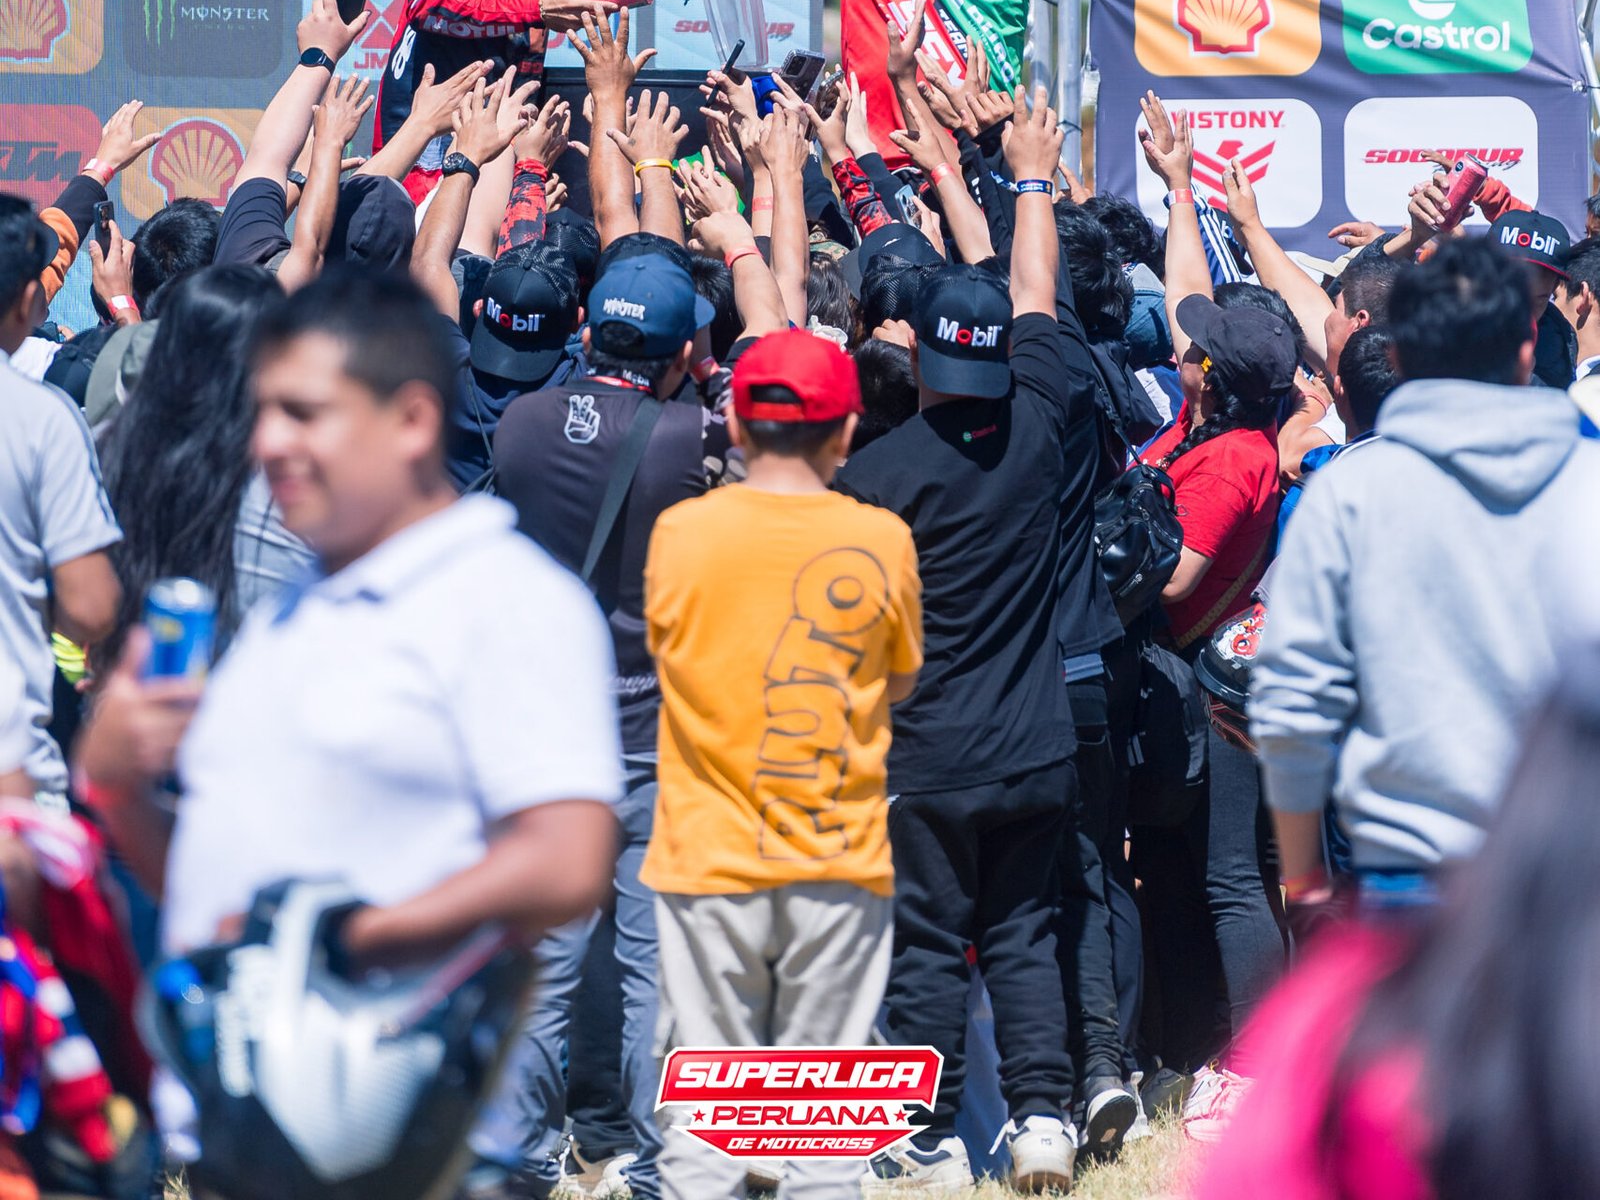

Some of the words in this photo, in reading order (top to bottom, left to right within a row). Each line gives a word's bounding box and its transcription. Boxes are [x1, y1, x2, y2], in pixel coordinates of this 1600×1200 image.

[181, 4, 270, 21] MONSTER
[423, 15, 517, 39] MOTUL
[1363, 18, 1510, 52] Castrol
[1500, 226, 1556, 256] Mobil
[487, 297, 540, 332] Mobil
[936, 316, 998, 347] Mobil
